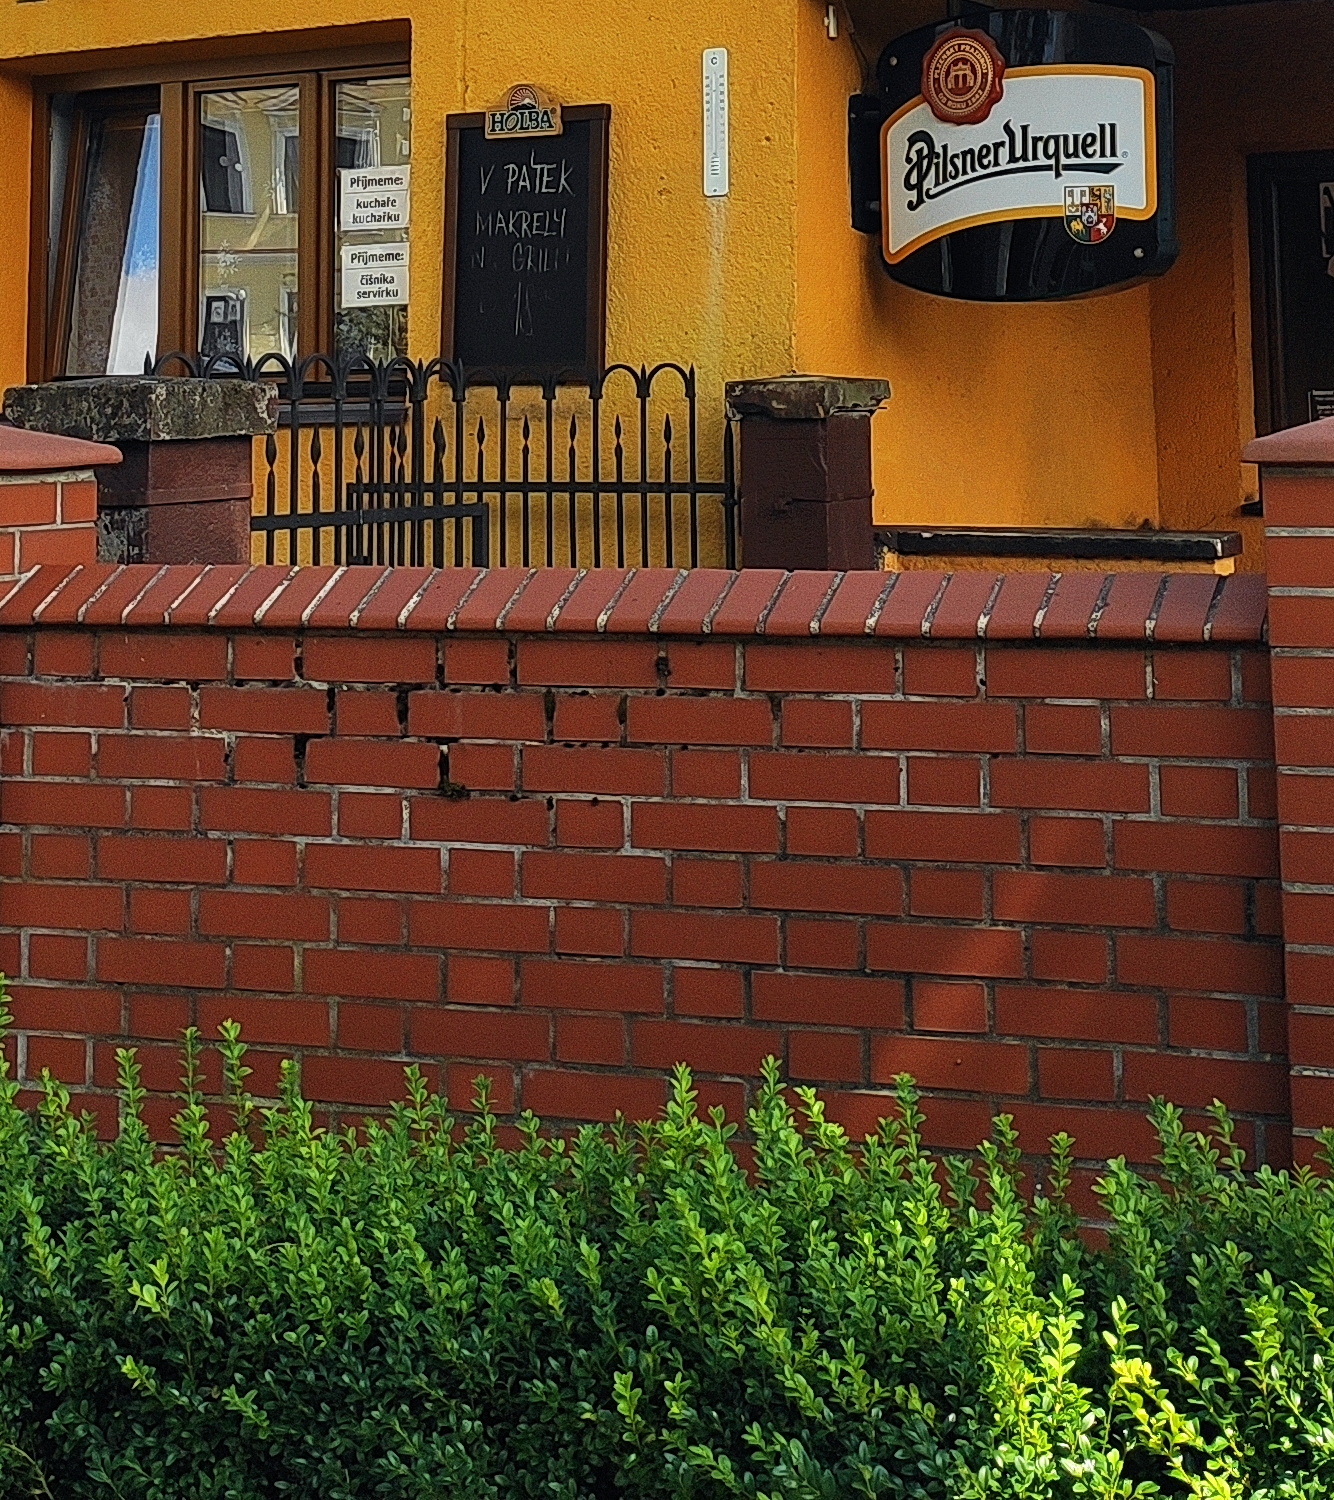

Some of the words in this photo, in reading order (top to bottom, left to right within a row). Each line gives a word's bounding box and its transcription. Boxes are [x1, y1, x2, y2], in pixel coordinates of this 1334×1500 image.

[488, 109, 556, 134] HOLBA
[903, 129, 1006, 212] Pilsner
[1001, 118, 1118, 180] Urquell
[479, 164, 496, 195] V
[355, 196, 397, 209] kuchaře
[351, 211, 401, 225] kuchařku
[475, 207, 567, 239] MAKRELY
[359, 272, 395, 286] číšníka
[356, 286, 399, 300] servírku
